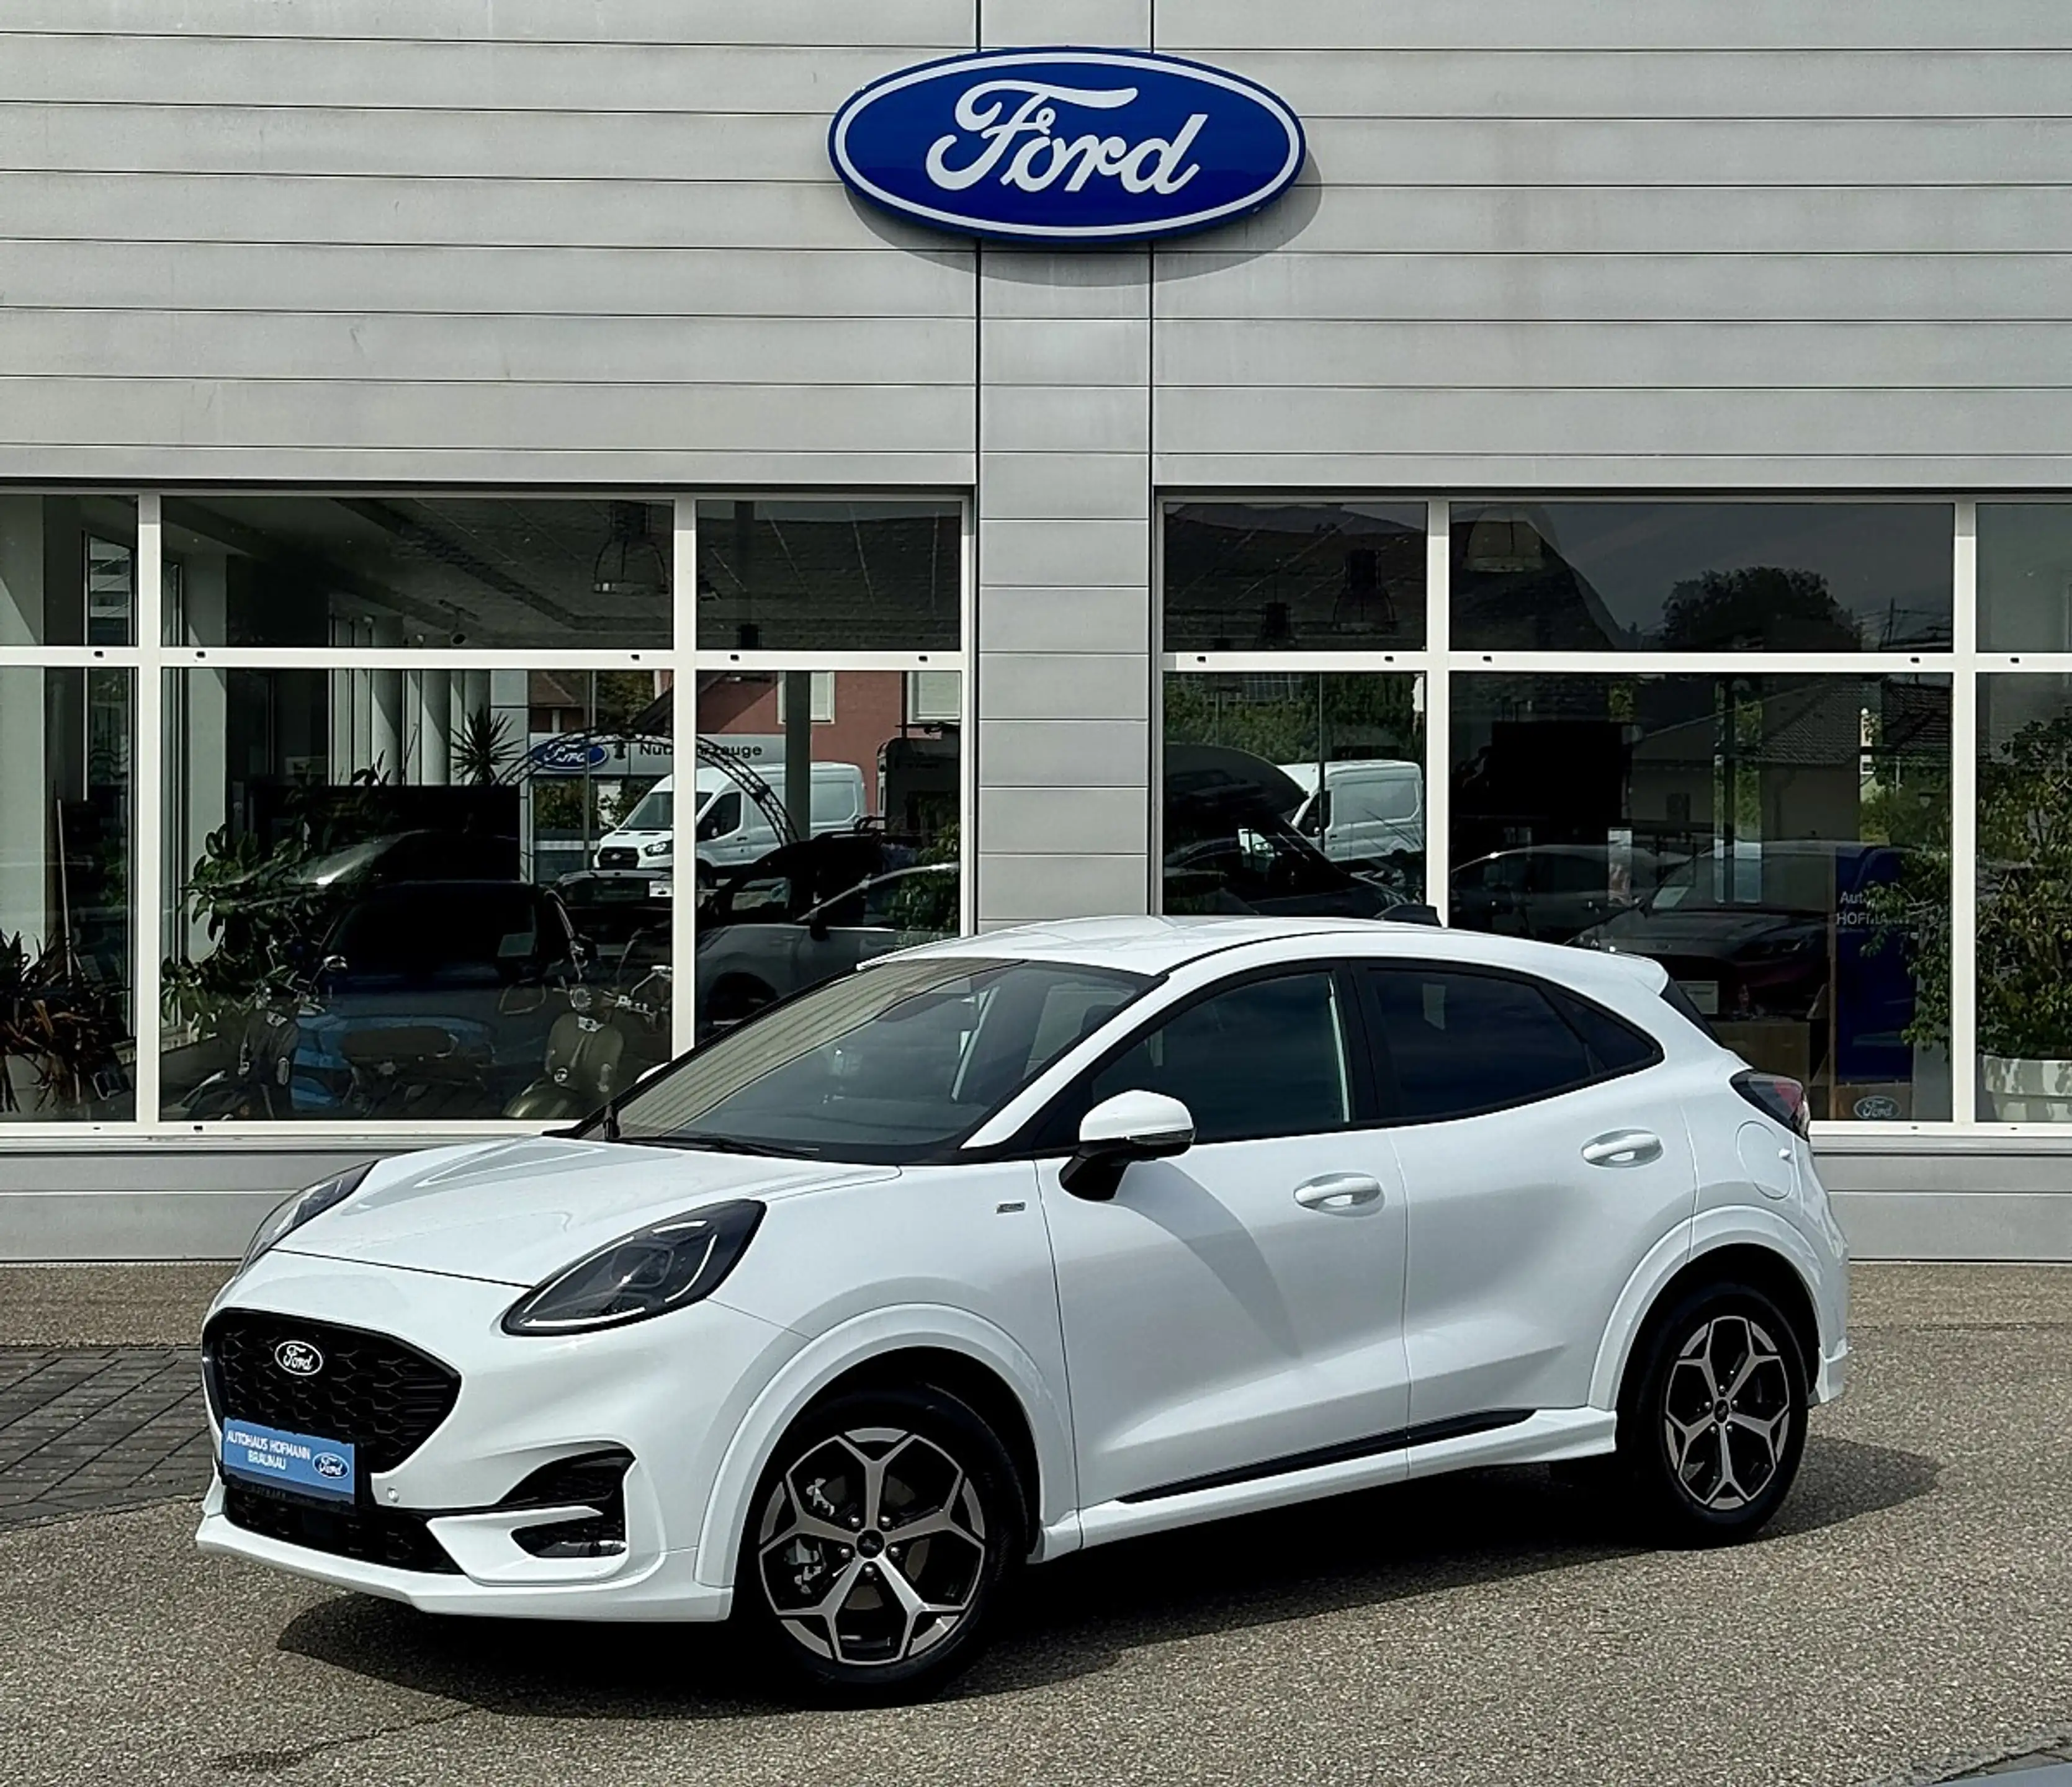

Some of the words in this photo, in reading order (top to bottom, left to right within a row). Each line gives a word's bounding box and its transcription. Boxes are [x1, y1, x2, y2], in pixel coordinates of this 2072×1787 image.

[925, 79, 1209, 194] Ford
[1862, 1100, 1893, 1117] Ford
[284, 1345, 313, 1371] Ford
[226, 1430, 268, 1450] AUTOHAUS
[269, 1440, 310, 1459] HOFMANN
[248, 1451, 286, 1470] BRAUNAU
[319, 1456, 343, 1475] Ford
